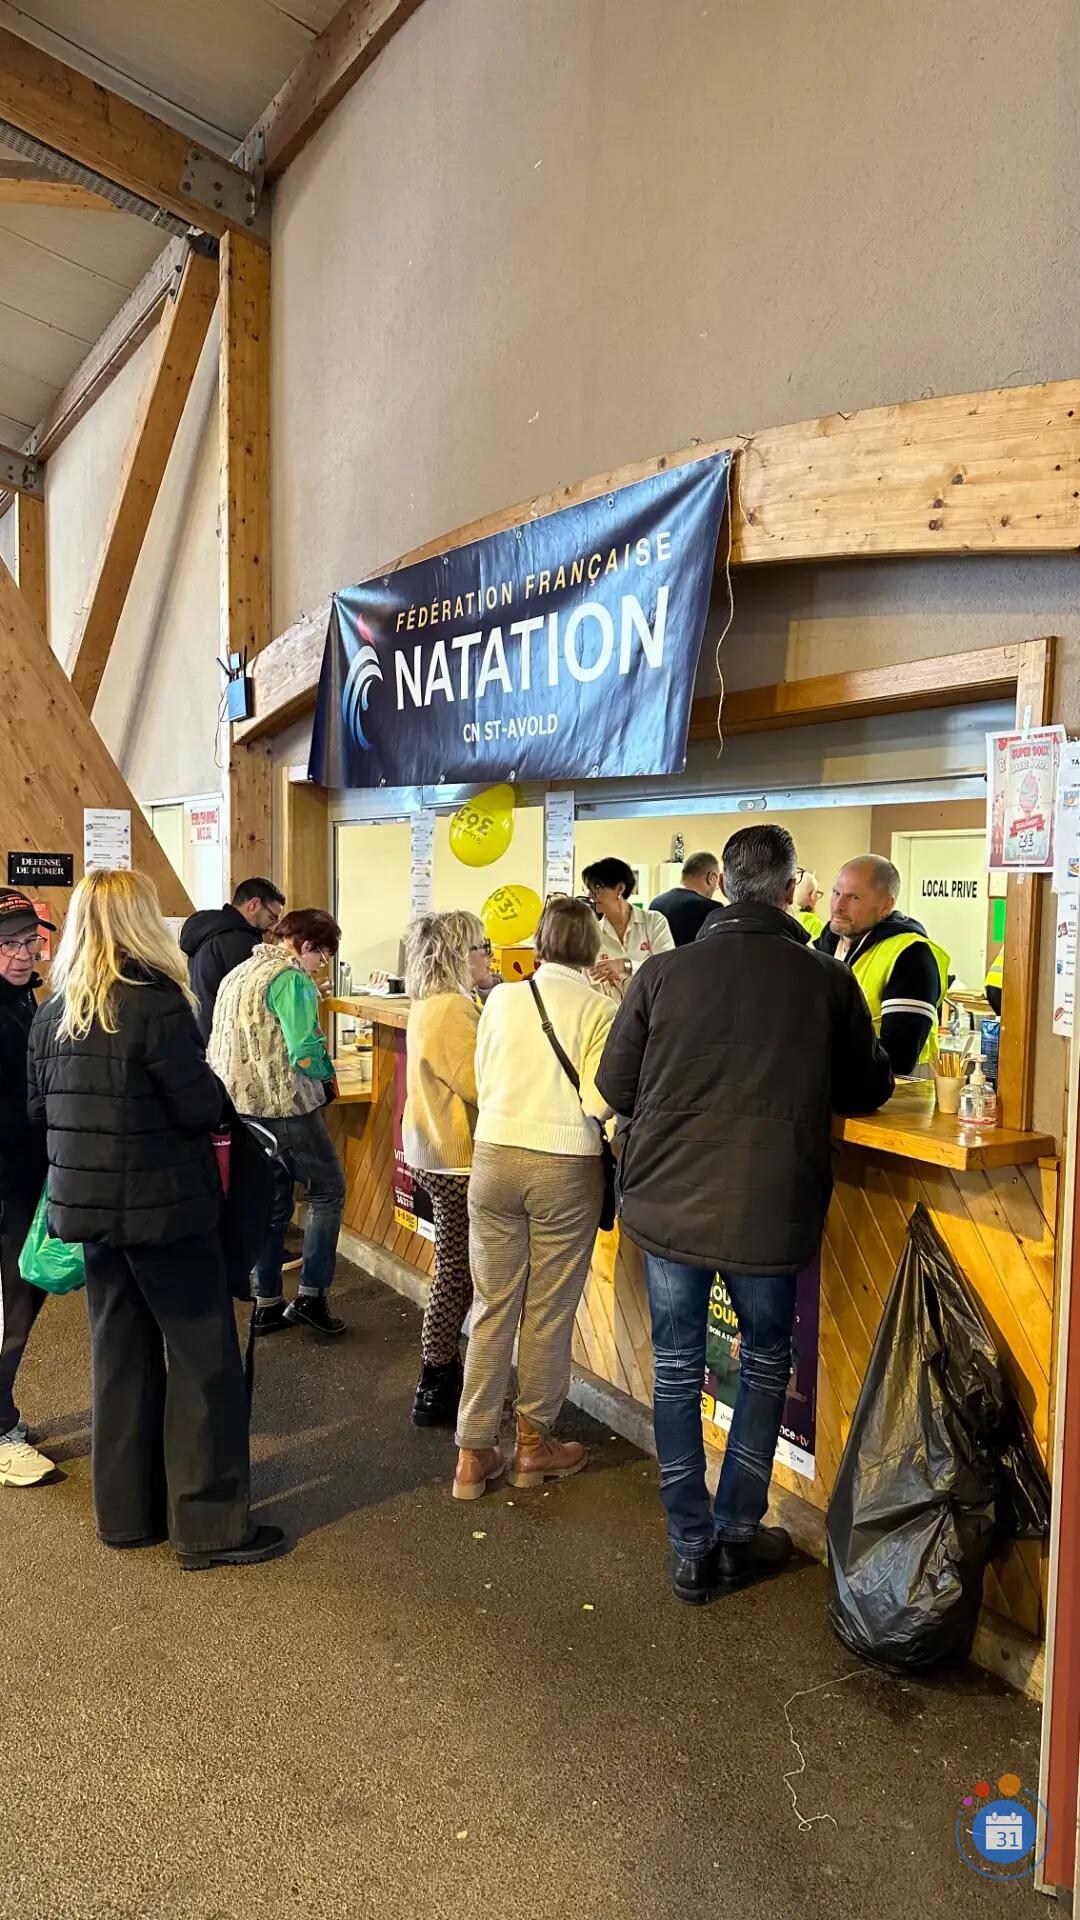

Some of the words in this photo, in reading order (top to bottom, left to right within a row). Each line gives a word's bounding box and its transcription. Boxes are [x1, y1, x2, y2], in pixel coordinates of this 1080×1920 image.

[395, 580, 513, 632] FÉDÉRATION
[525, 531, 672, 599] FRANÇAISE
[394, 585, 670, 710] NATATION
[463, 723, 480, 743] CN
[484, 713, 558, 741] ST-AVOLD
[16, 866, 29, 874] DE
[32, 867, 65, 875] FUMER
[21, 857, 61, 867] DEFENSE
[922, 880, 949, 897] LOCAL
[951, 880, 978, 898] PRIVE
